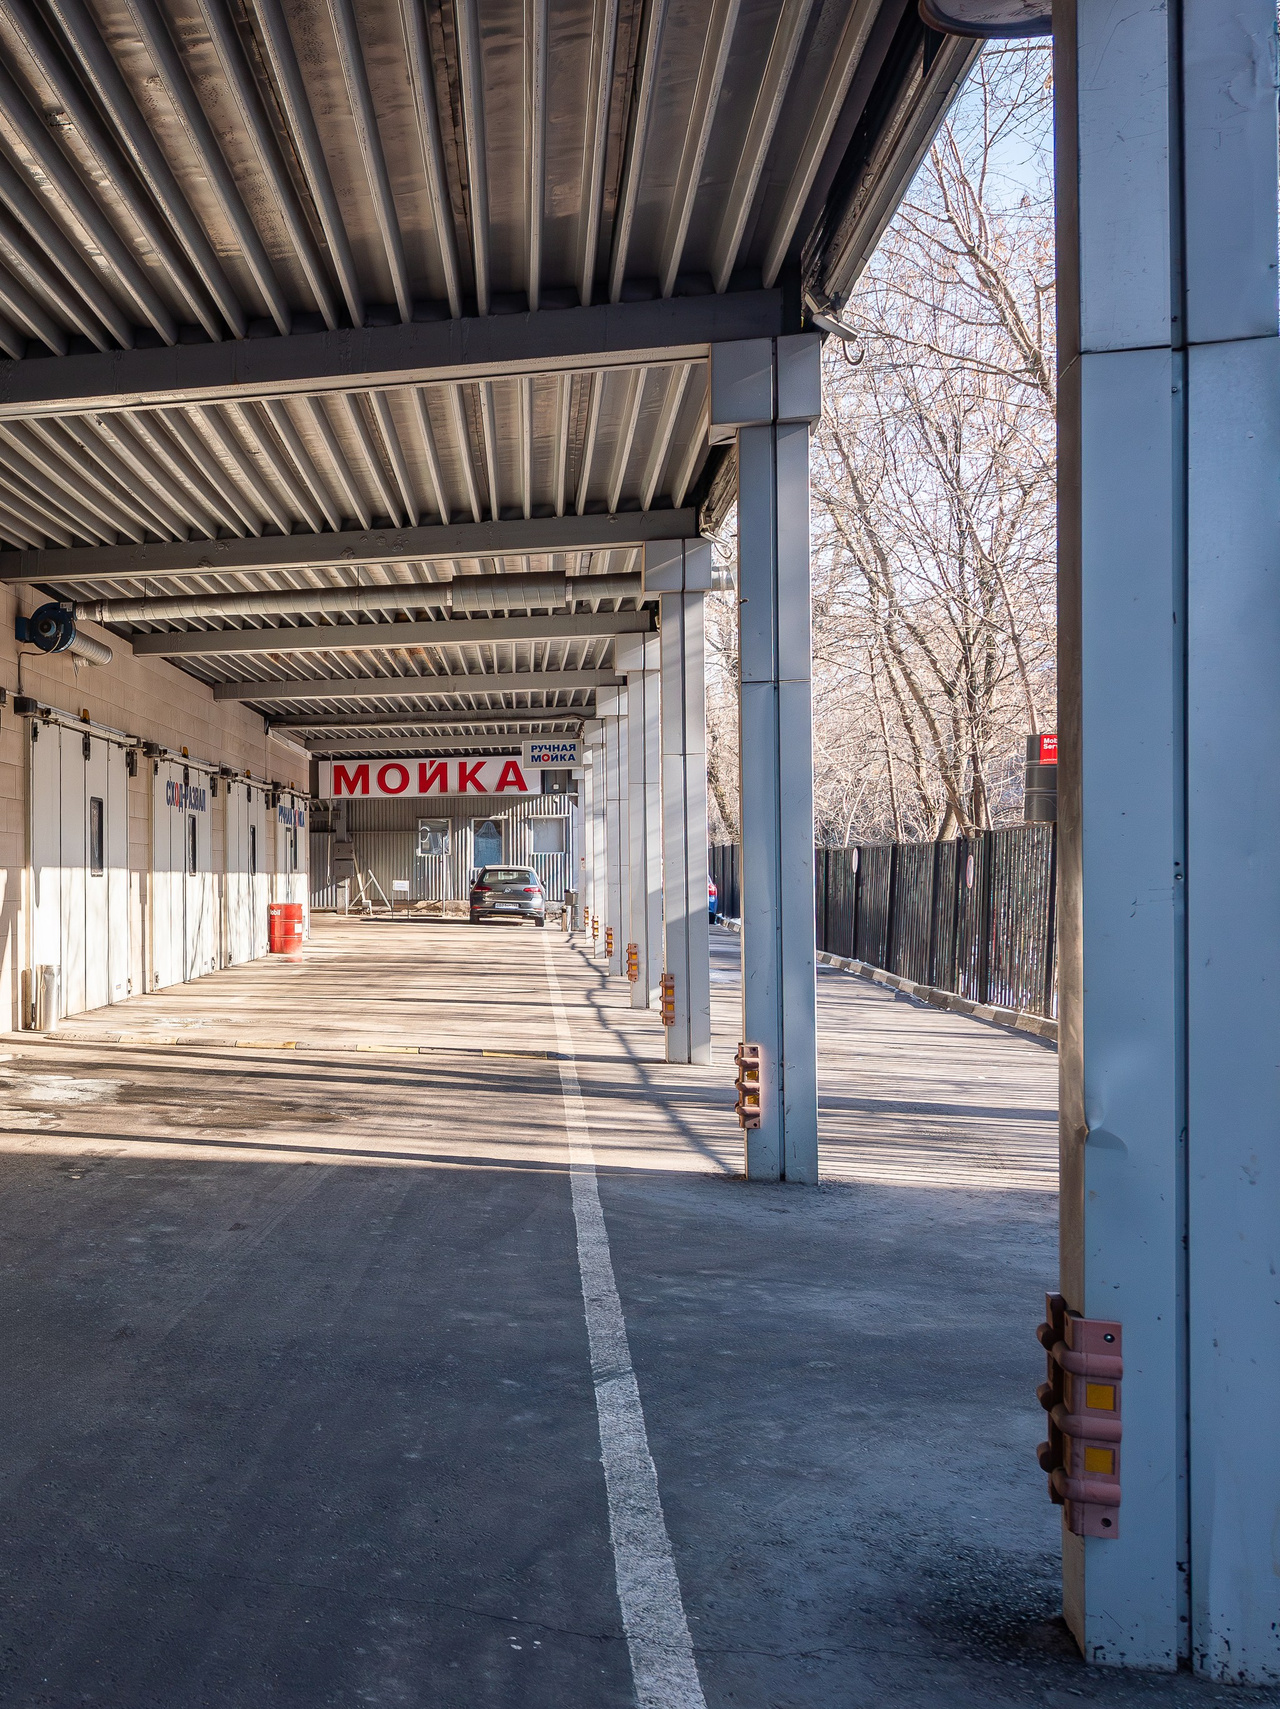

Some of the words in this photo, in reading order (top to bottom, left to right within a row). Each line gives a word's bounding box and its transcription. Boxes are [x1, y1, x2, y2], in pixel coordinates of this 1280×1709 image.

[530, 743, 577, 753] РУЧНАЯ
[530, 752, 577, 763] МОЙКА
[333, 759, 529, 796] МОЙКА
